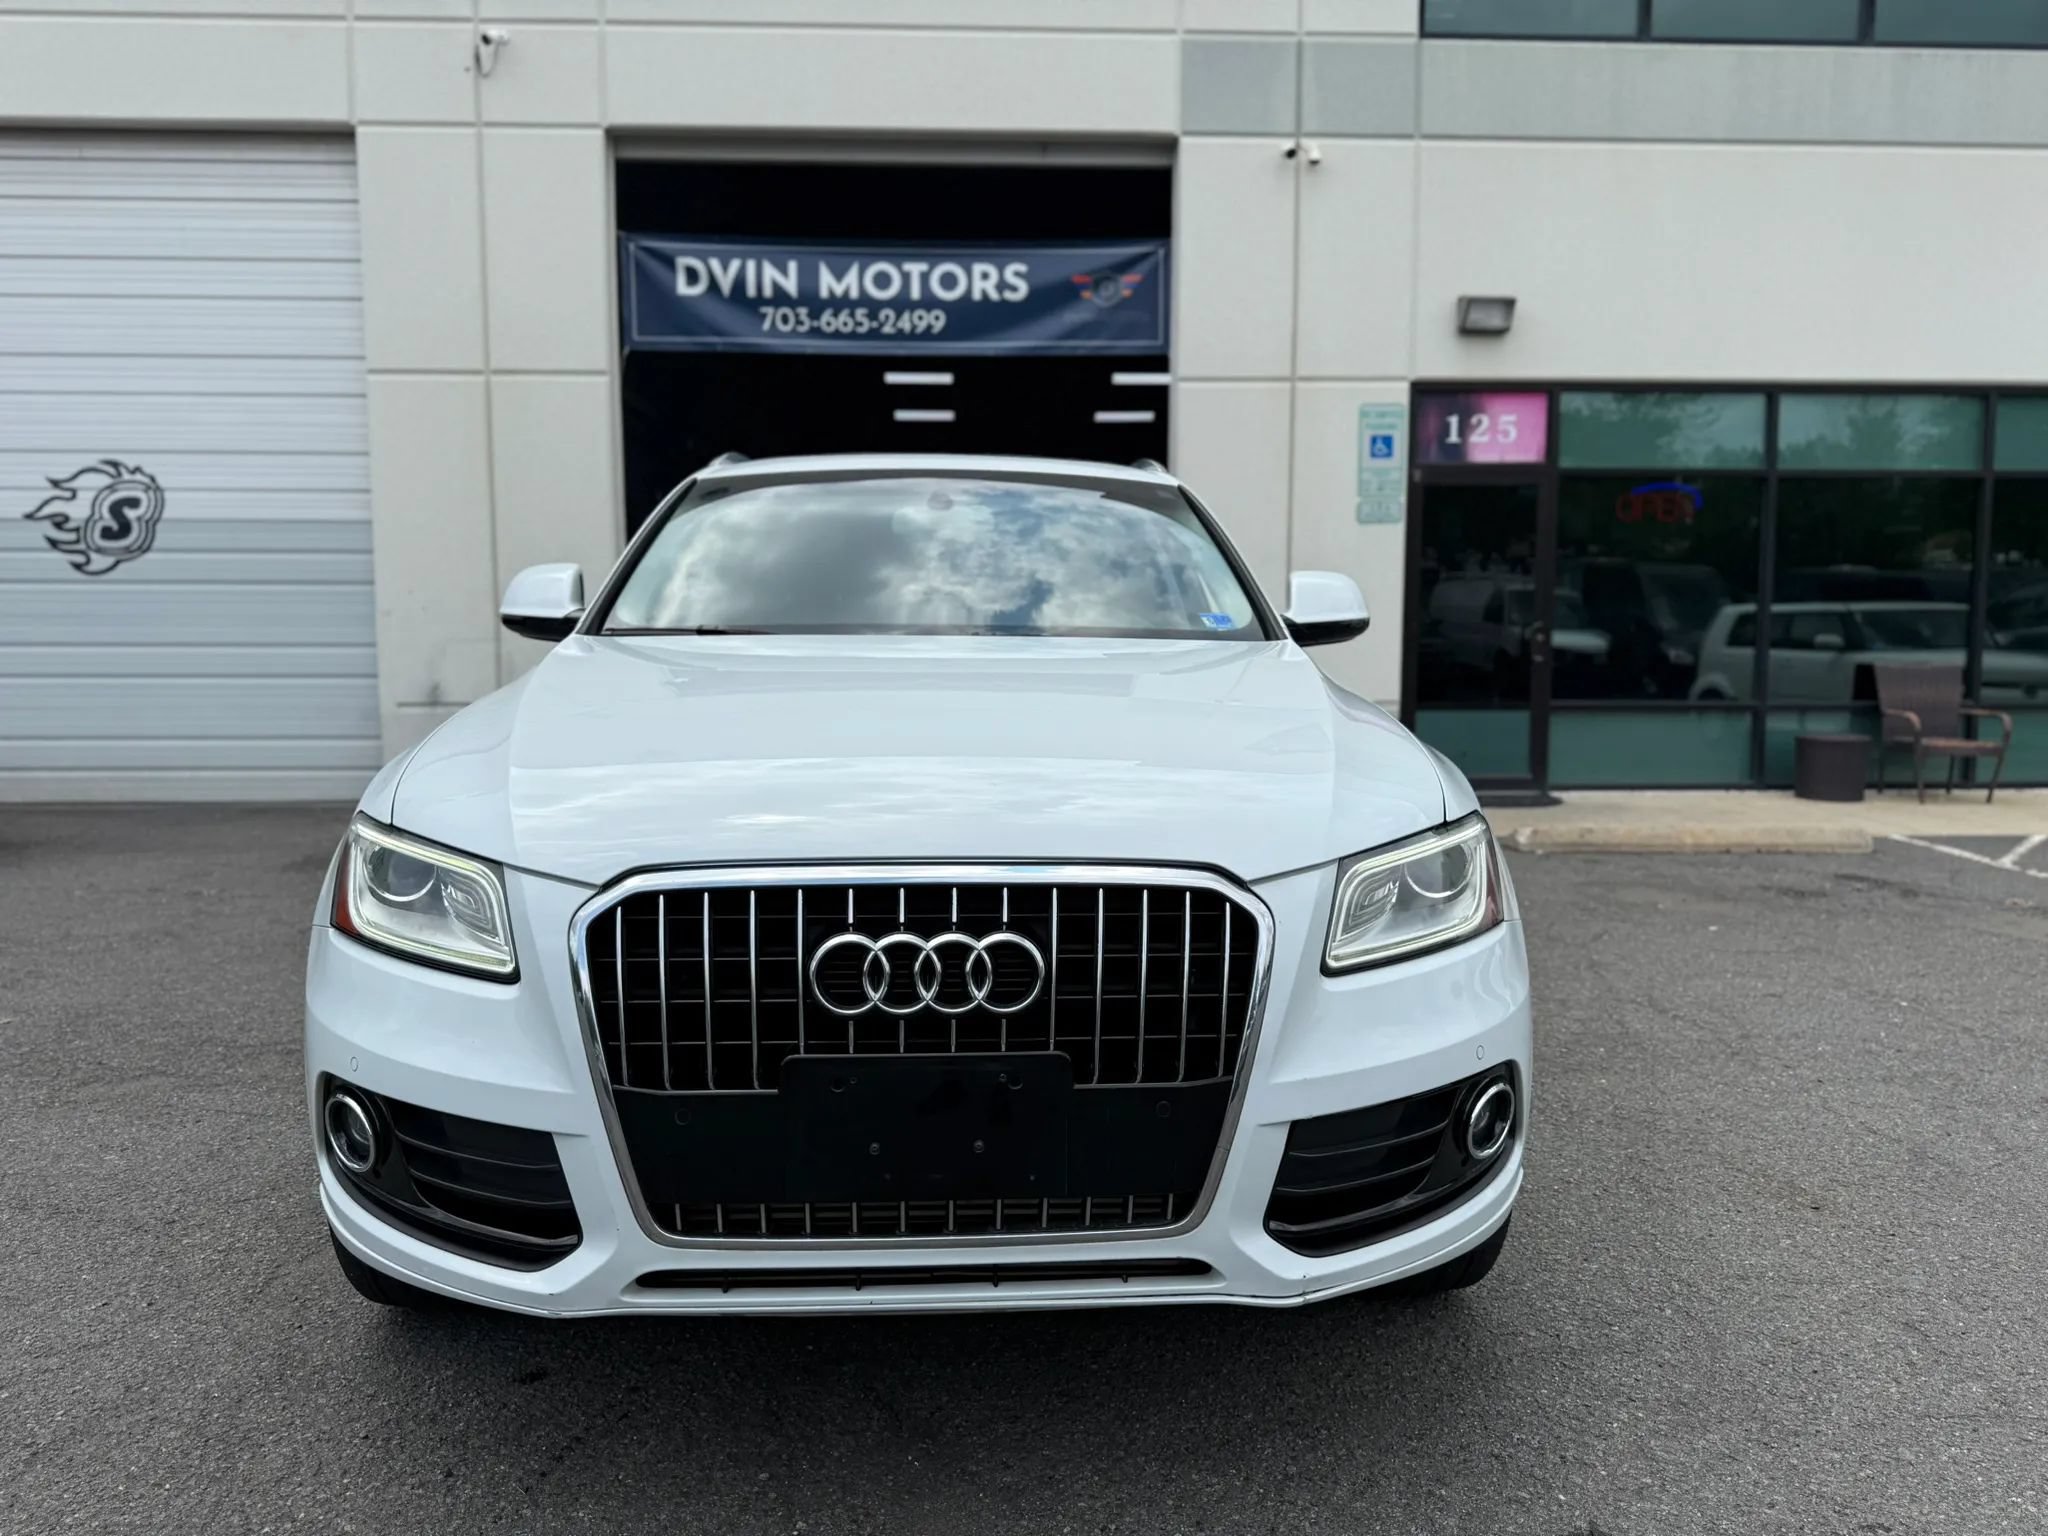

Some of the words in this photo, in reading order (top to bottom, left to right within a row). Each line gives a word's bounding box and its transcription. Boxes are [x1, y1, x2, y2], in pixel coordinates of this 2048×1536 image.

[674, 256, 799, 299] DVIN
[818, 260, 1030, 302] MOTORS
[758, 305, 947, 335] 703-665-2499
[1444, 413, 1519, 445] 125
[99, 496, 142, 541] S
